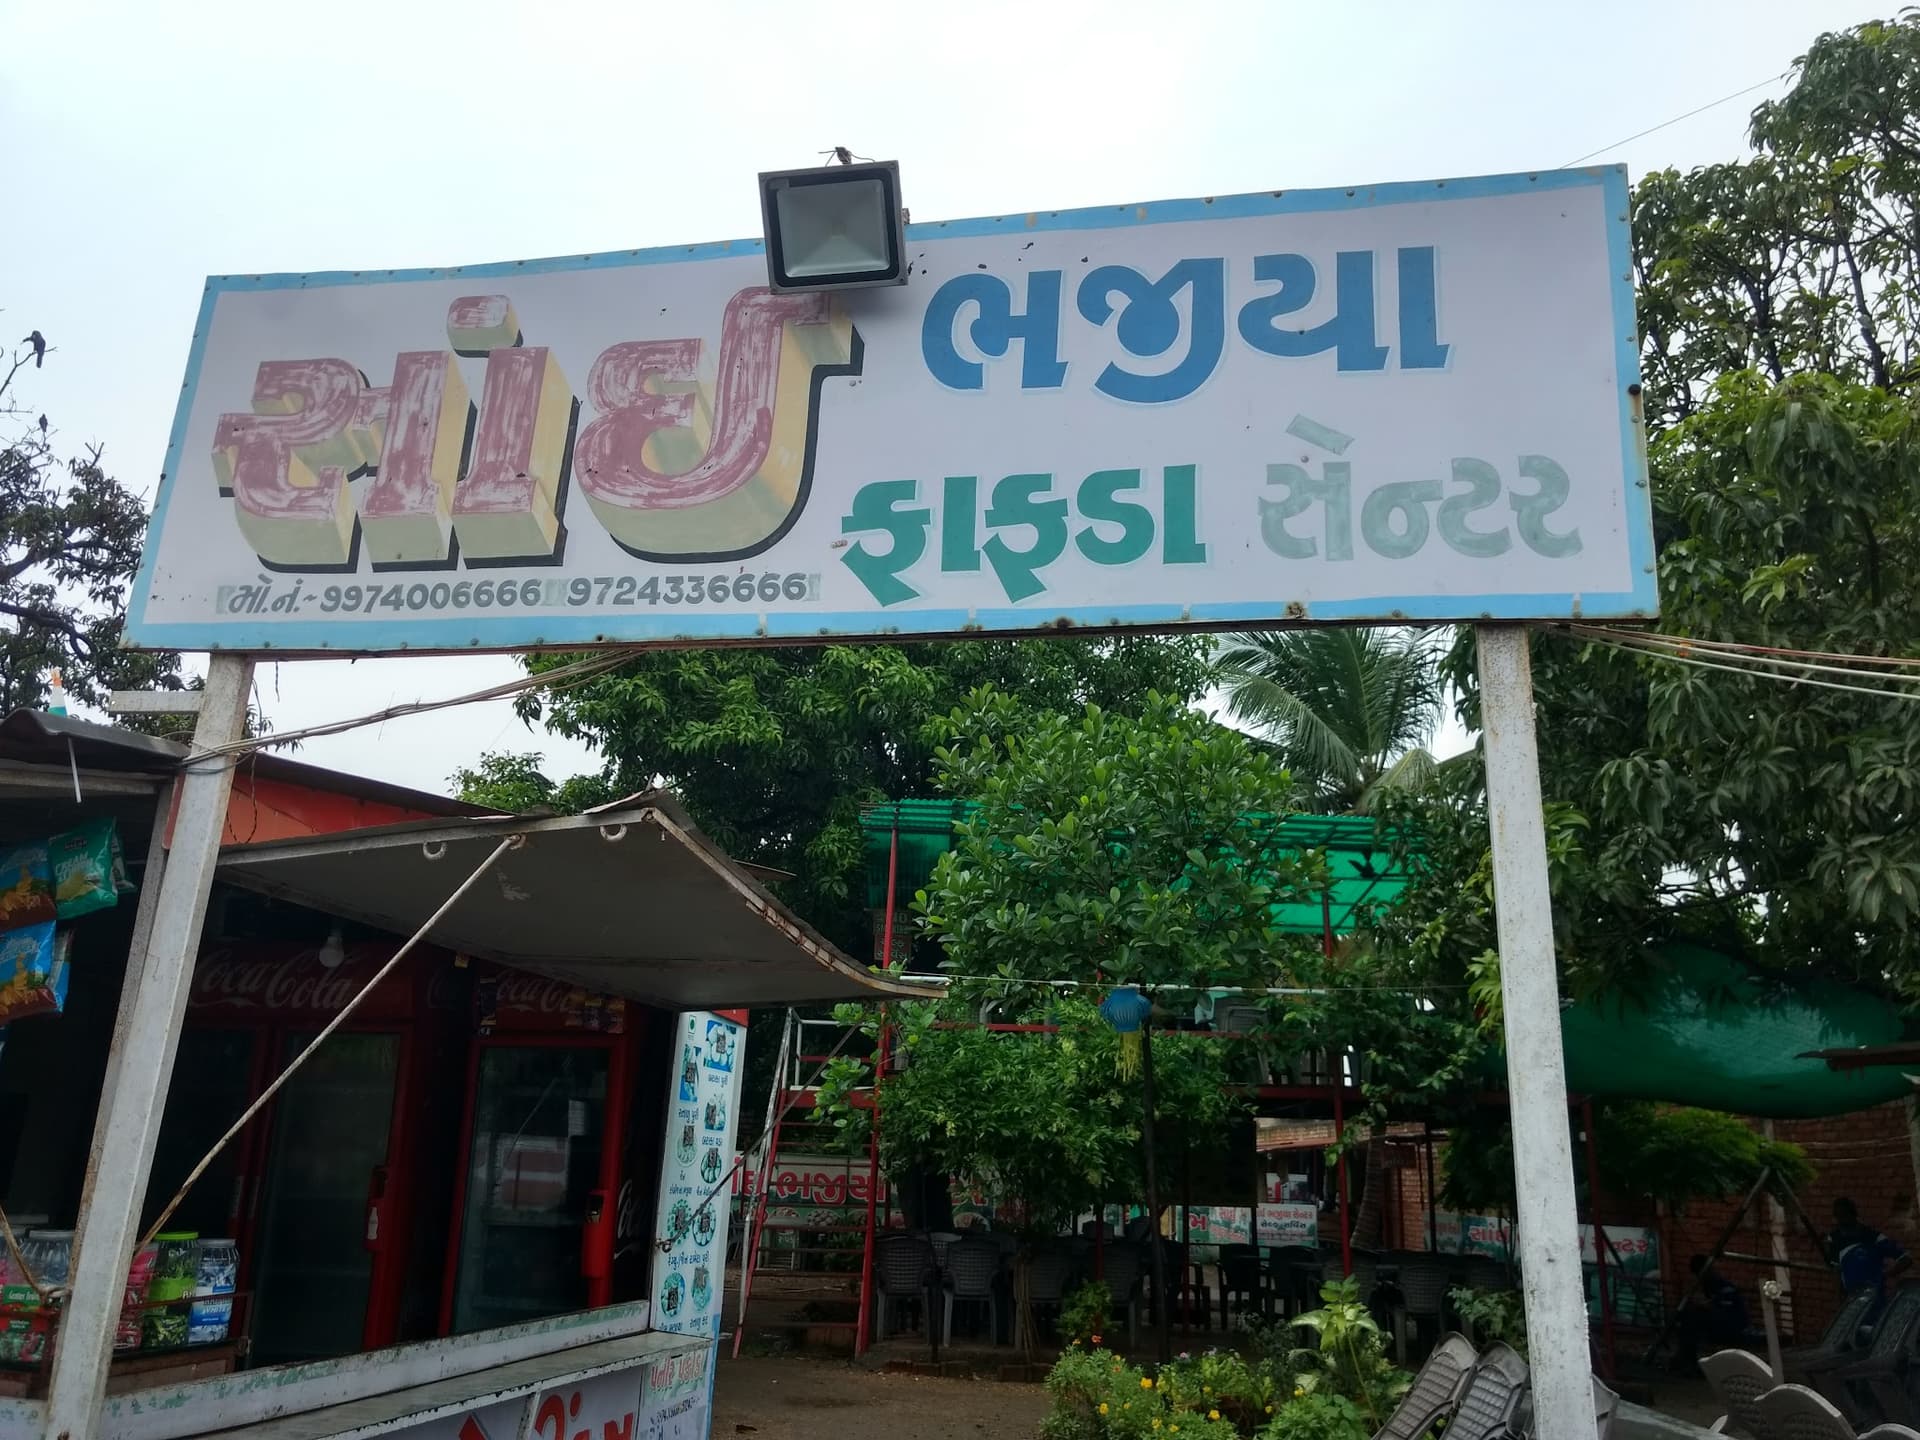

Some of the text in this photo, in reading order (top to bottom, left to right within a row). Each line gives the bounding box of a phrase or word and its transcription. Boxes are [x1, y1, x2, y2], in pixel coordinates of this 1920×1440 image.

[920, 245, 1453, 404] ભજીયા
[567, 572, 808, 608] 9724336666
[840, 464, 1208, 607] ફાફડા
